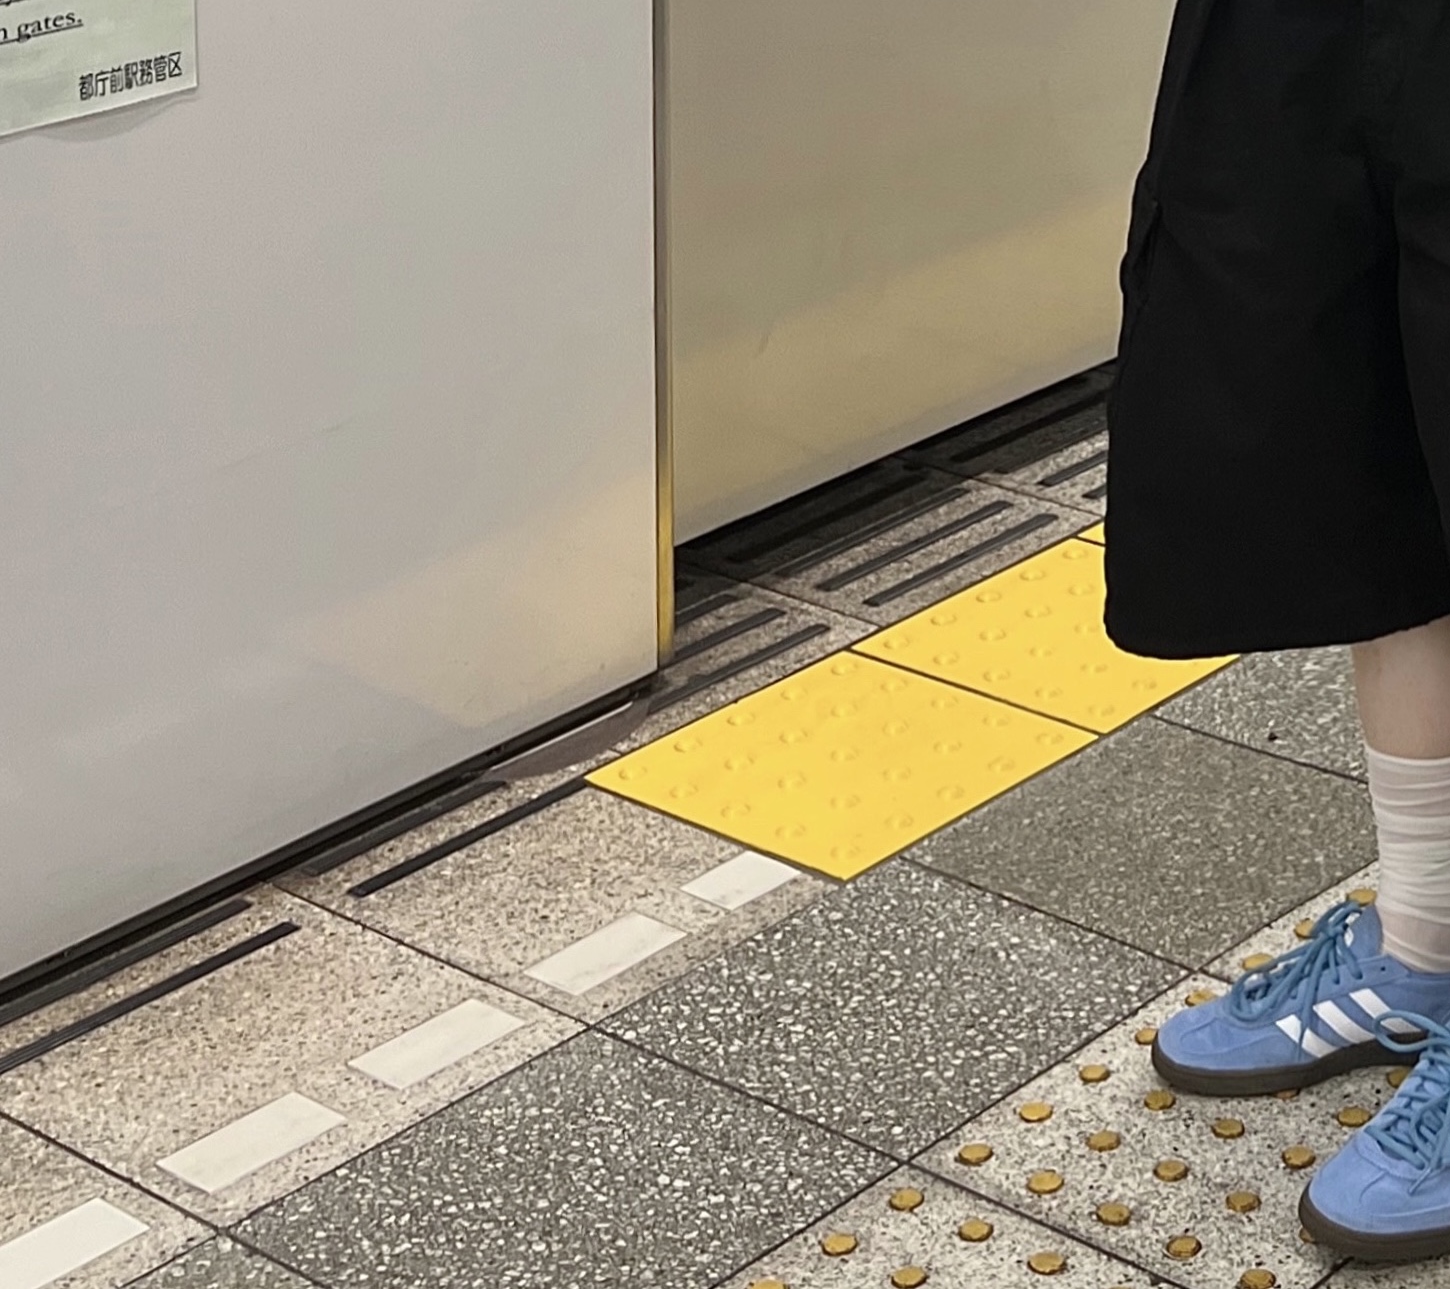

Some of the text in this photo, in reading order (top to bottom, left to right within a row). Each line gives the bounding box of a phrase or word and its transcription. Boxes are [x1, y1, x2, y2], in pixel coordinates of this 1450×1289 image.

[17, 11, 82, 42] gates.
[79, 51, 182, 101] 都庁前駅務管区
